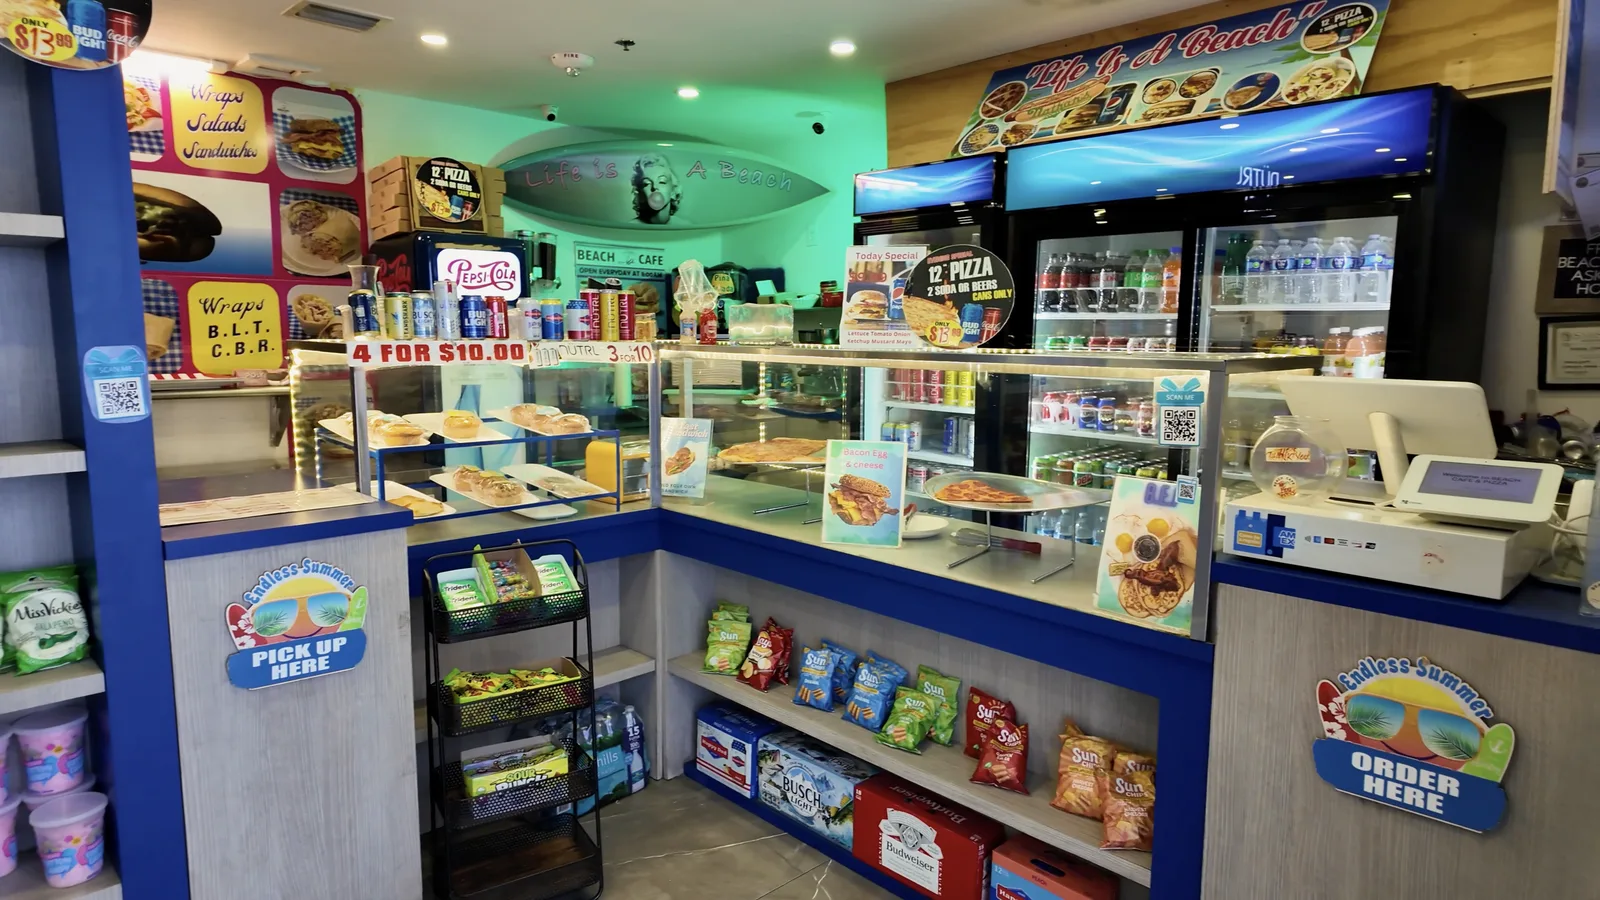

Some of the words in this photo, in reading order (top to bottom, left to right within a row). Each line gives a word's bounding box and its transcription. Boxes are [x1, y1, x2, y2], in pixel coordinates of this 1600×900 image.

[21, 17, 49, 28] ONLY
[1334, 7, 1362, 22] PIZZA
[72, 25, 103, 39] BUD
[1095, 45, 1125, 77] Is
[1130, 34, 1172, 69] A
[191, 84, 244, 110] Wraps
[186, 112, 247, 133] Salads
[183, 141, 259, 160] Sandwiches
[445, 167, 470, 183] PIZZA
[525, 163, 582, 188] Life
[594, 159, 618, 180] is
[687, 160, 707, 180] A
[719, 160, 793, 192] Beach
[577, 249, 615, 262] BEACH
[638, 254, 664, 266] CAFE
[856, 252, 883, 261] Today
[885, 252, 918, 260] Special
[580, 266, 598, 274] OPEN
[599, 268, 632, 277] EVERYDAY
[950, 256, 993, 281] PIZZA
[935, 284, 957, 296] SODA
[958, 282, 970, 293] OR
[972, 279, 998, 291] BEERS
[972, 291, 992, 301] CANS
[993, 289, 1013, 299] ONLY
[199, 297, 265, 320] Wraps
[353, 344, 372, 362] 4
[380, 343, 431, 362] FOR
[439, 342, 525, 363] $10.00
[607, 344, 619, 361] 3
[620, 354, 636, 362] FOR
[844, 449, 871, 457] Bacon
[872, 449, 888, 459] Egg
[853, 461, 884, 469] cheese
[244, 563, 299, 605] Endless
[302, 559, 356, 590] Summer
[444, 584, 471, 592] Trident
[720, 631, 738, 641] Sun
[252, 644, 311, 668] PICK
[316, 636, 347, 656] UP
[805, 653, 827, 665] Sun
[271, 656, 330, 681] HERE
[858, 669, 879, 684] Sun
[923, 681, 945, 696] Sun
[1339, 657, 1410, 691] Endless
[1416, 656, 1493, 720] Summer
[905, 697, 926, 707] Sun
[627, 725, 640, 737] 15
[1072, 747, 1099, 763] Sun
[506, 768, 537, 783] SOUR
[1351, 751, 1461, 798] ORDER
[783, 776, 821, 808] BUSCH
[1115, 777, 1143, 793] Sun
[1363, 774, 1445, 815] HERE
[791, 795, 814, 812] LIGHT
[890, 784, 967, 825] Budweiser
[886, 840, 935, 873] Budweiser
